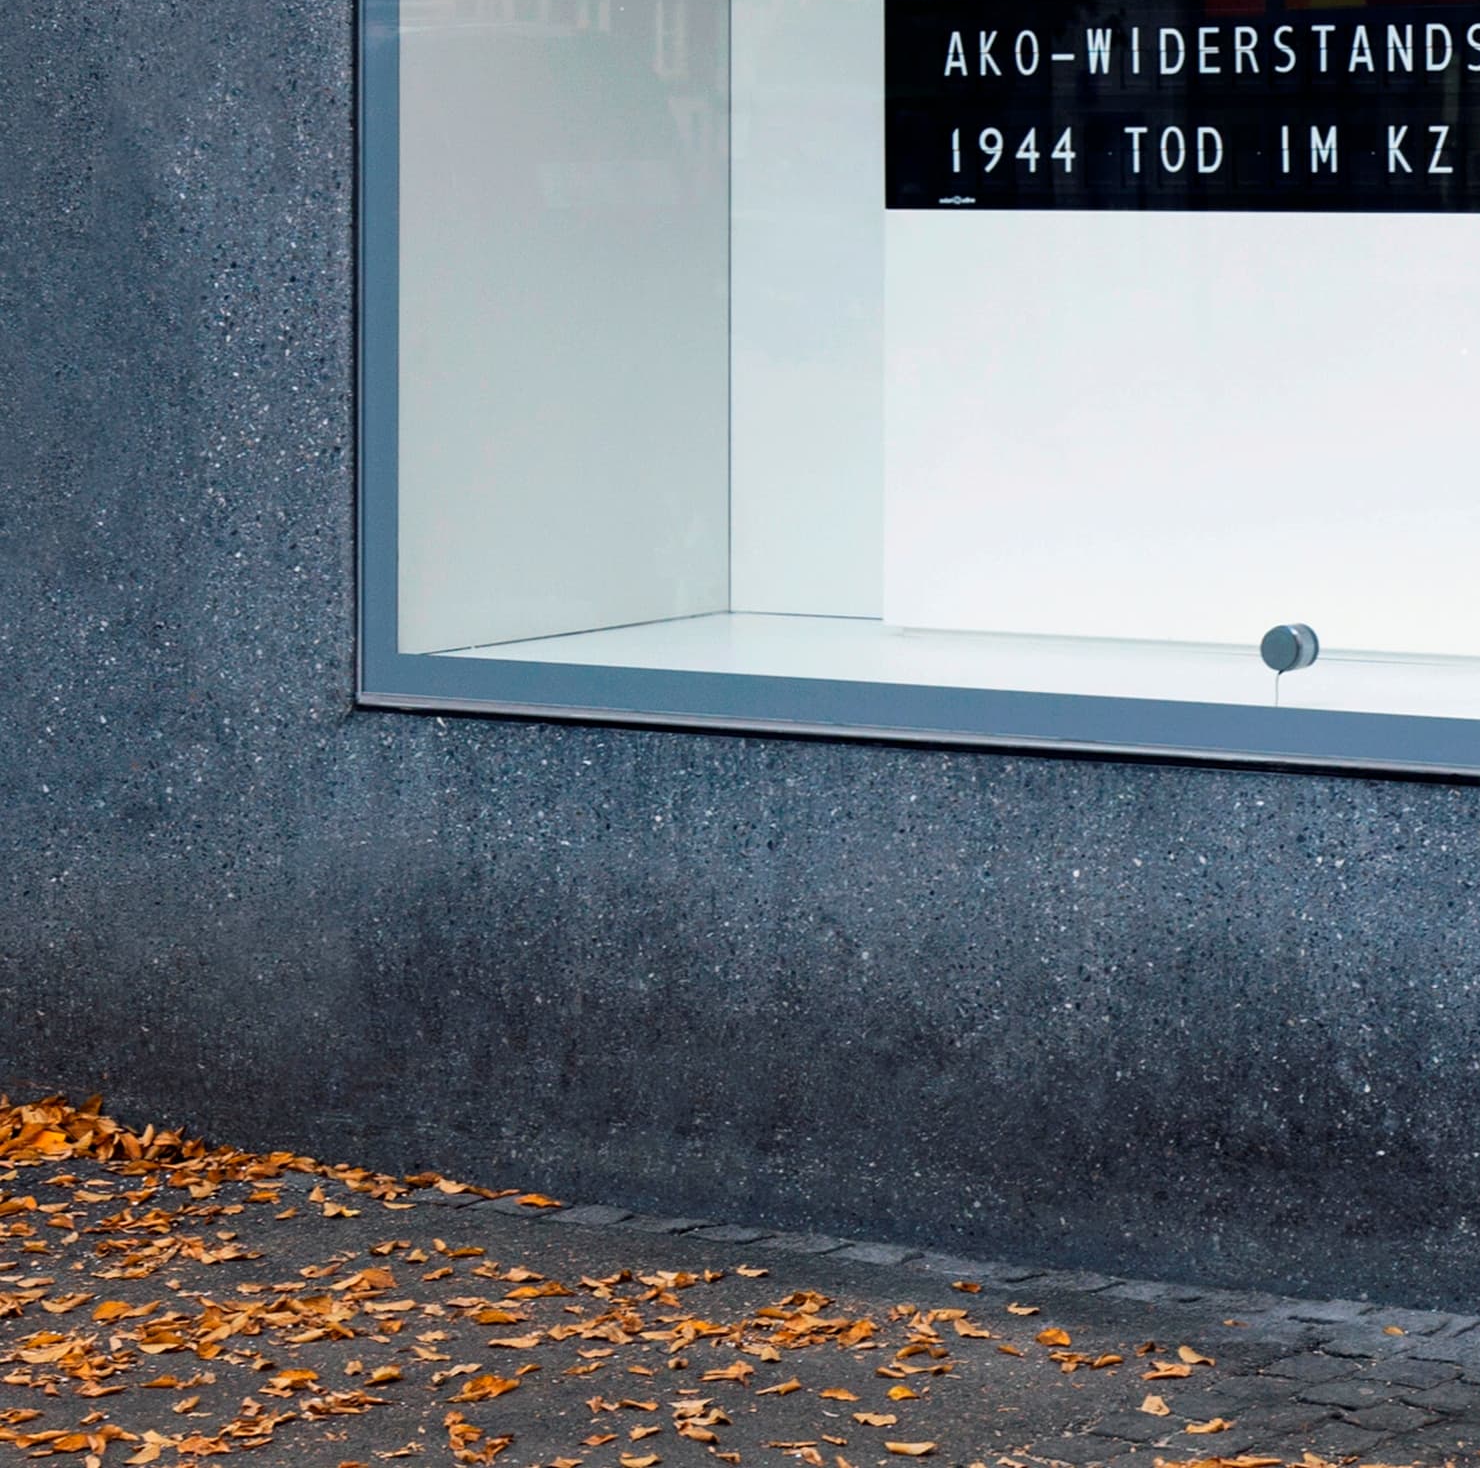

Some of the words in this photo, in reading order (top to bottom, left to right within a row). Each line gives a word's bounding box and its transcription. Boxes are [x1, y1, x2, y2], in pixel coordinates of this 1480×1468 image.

[951, 125, 1077, 174] 1944
[1124, 125, 1224, 174] TOD
[1280, 125, 1339, 174] IM
[1386, 125, 1454, 174] KZ
